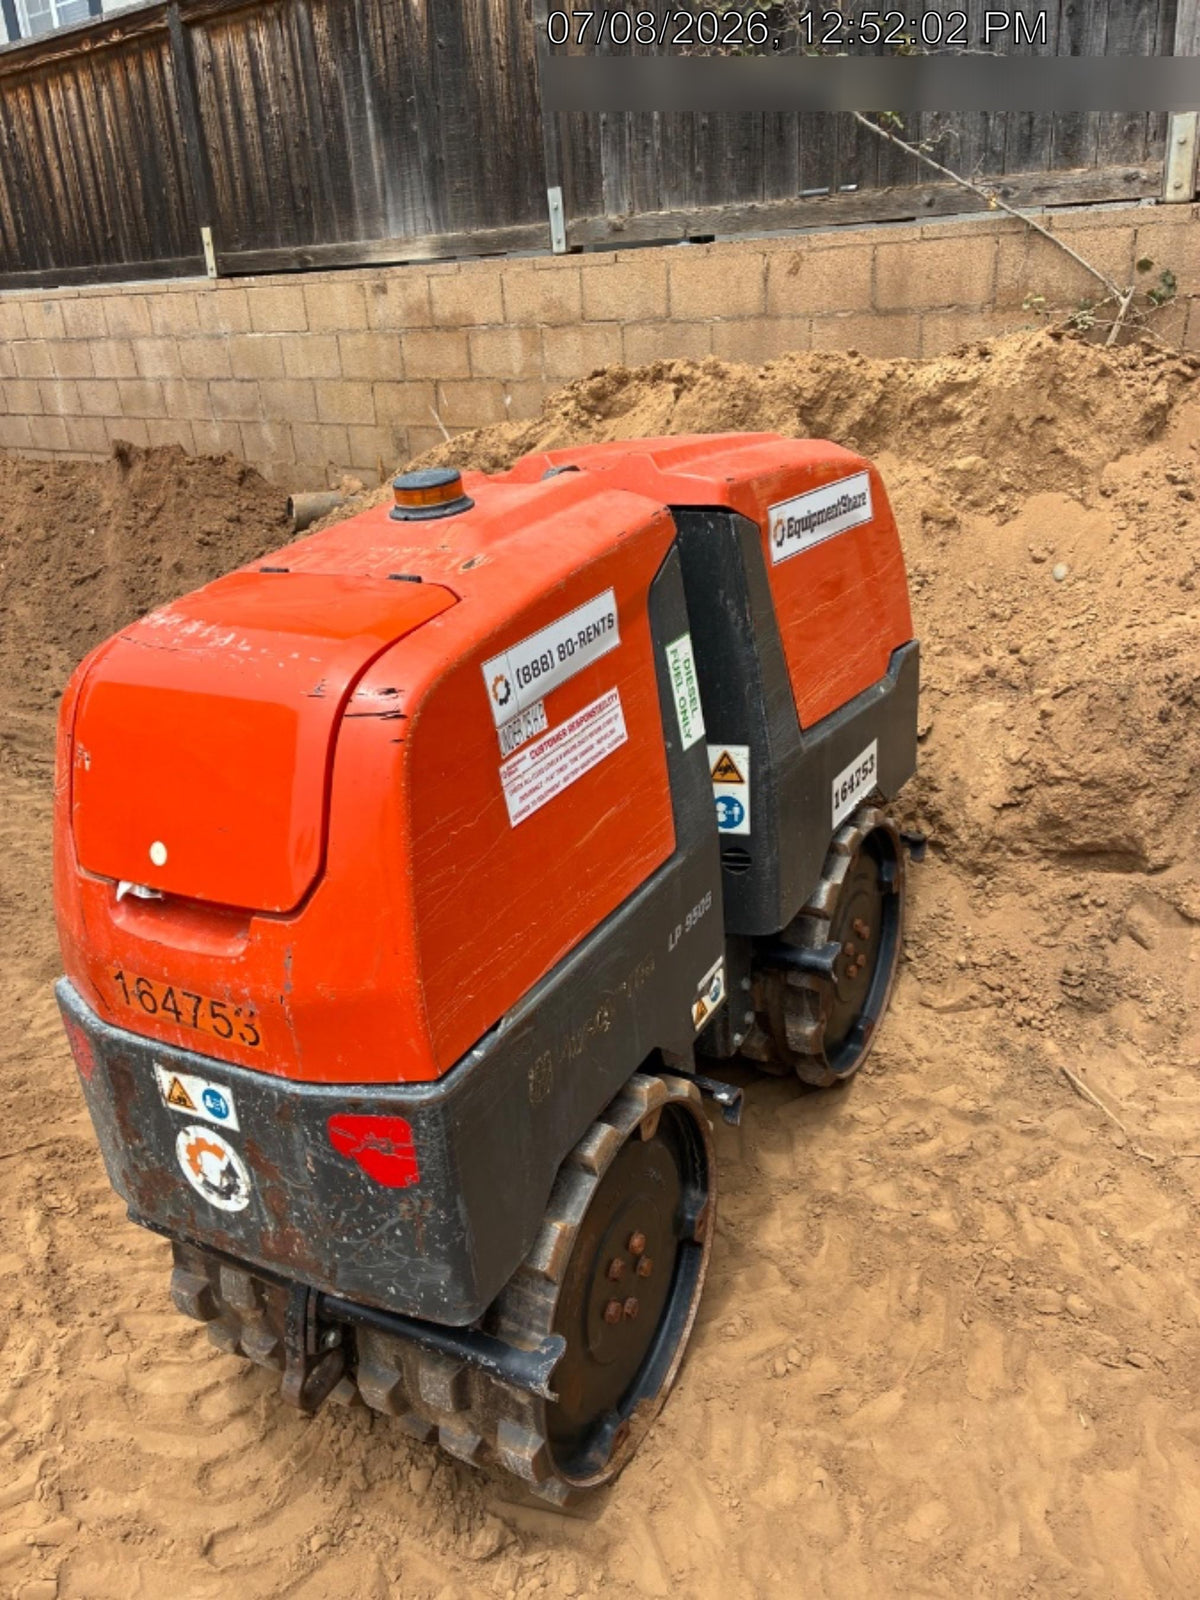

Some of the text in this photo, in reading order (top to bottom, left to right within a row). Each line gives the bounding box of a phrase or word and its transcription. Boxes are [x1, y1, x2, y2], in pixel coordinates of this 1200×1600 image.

[787, 491, 867, 539] EquipmentShare
[515, 612, 615, 689] (888) 80-RENTS
[670, 648, 692, 739] FUEL ONLY
[683, 657, 698, 718] DIESEL
[834, 753, 875, 810] 164753
[668, 923, 682, 952] LP
[114, 970, 261, 1046] 164753
